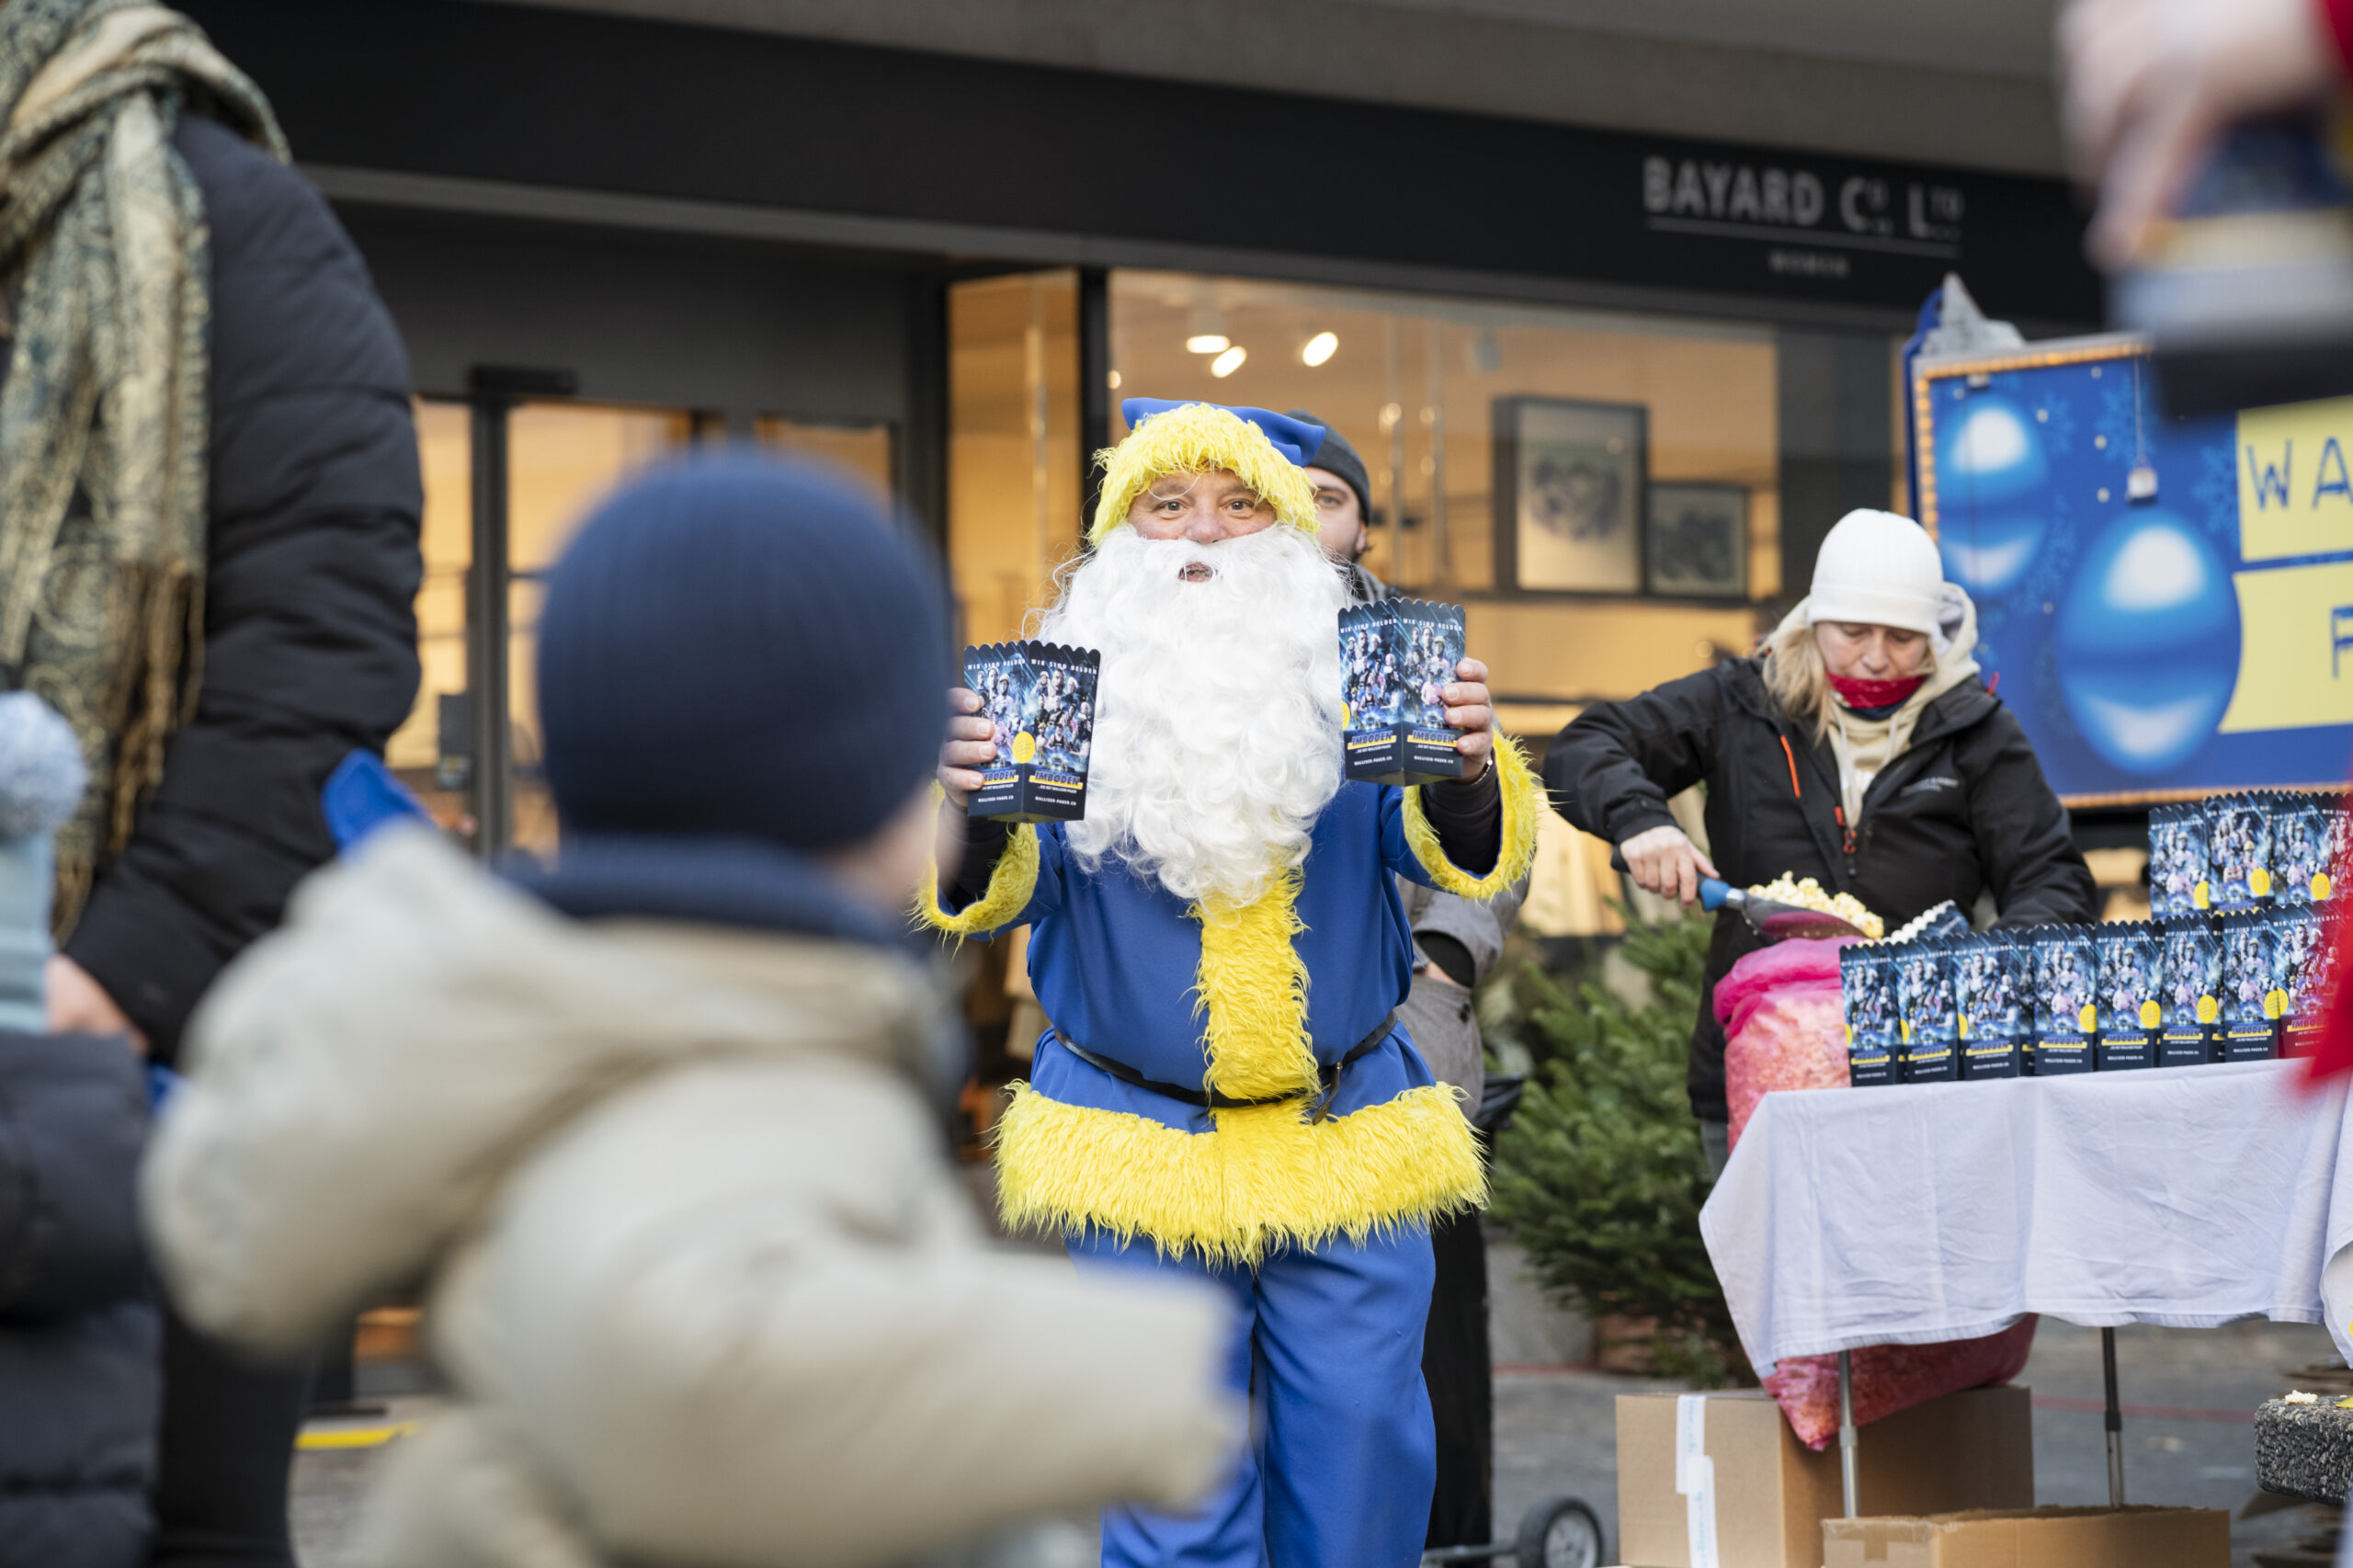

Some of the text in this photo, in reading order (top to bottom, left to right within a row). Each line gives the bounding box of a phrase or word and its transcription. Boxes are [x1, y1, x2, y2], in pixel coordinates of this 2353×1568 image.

[1643, 156, 1824, 226] BAYARD
[1352, 730, 1393, 744] IMBODEN
[1412, 730, 1456, 743] IMBODEN
[1035, 770, 1081, 785] IMBODEN
